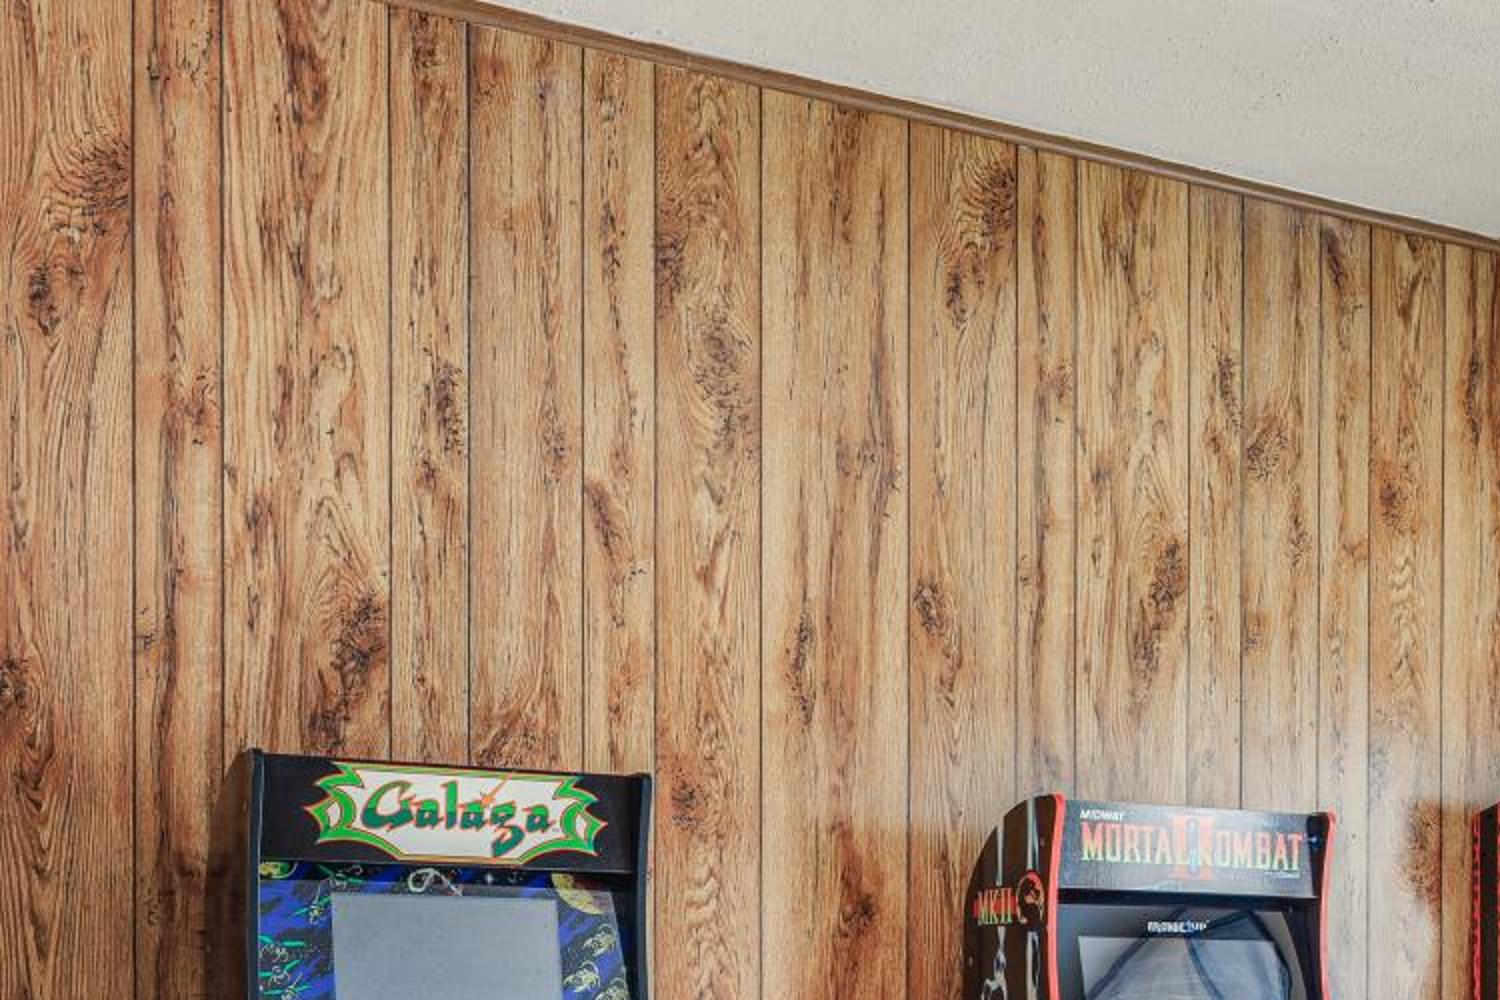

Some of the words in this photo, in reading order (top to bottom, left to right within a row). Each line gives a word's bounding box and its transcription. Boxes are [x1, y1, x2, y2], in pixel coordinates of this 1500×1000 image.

[361, 779, 556, 858] Galaga
[1080, 820, 1190, 866] MORTAL
[1199, 827, 1303, 871] KOMBAT
